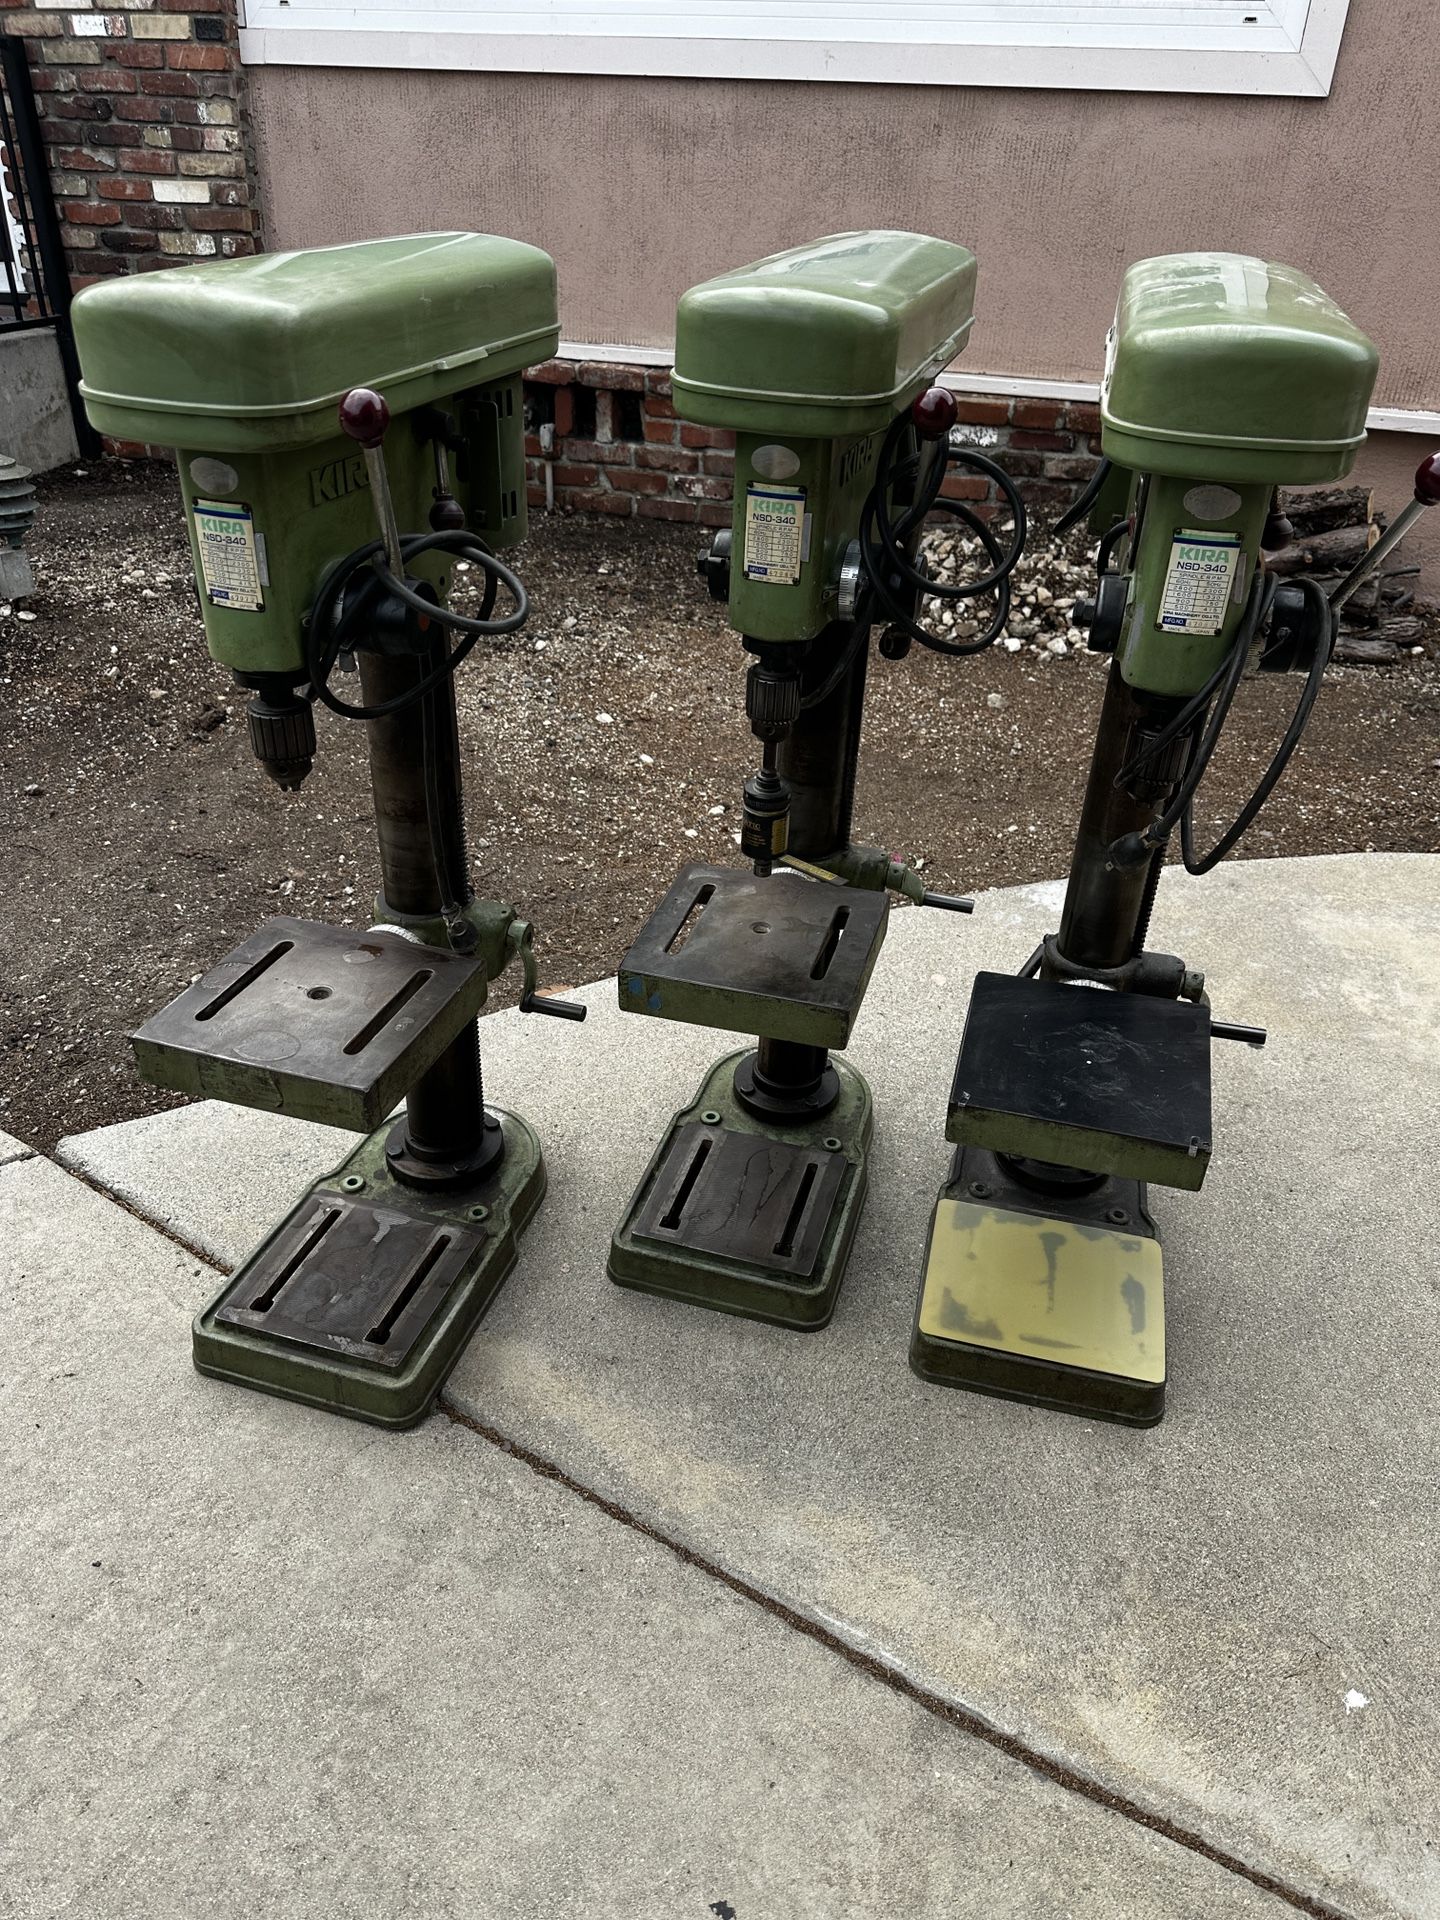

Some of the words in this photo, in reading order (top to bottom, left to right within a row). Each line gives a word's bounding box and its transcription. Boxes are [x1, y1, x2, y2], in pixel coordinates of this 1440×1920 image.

[840, 436, 872, 488] KIRA
[309, 452, 370, 507] KIR
[752, 499, 796, 515] KIRA
[201, 517, 246, 535] KIRA
[752, 513, 796, 525] NSD-340
[203, 532, 247, 546] NSD-340
[1179, 547, 1230, 563] KIRA
[1177, 561, 1228, 573] NSD-340
